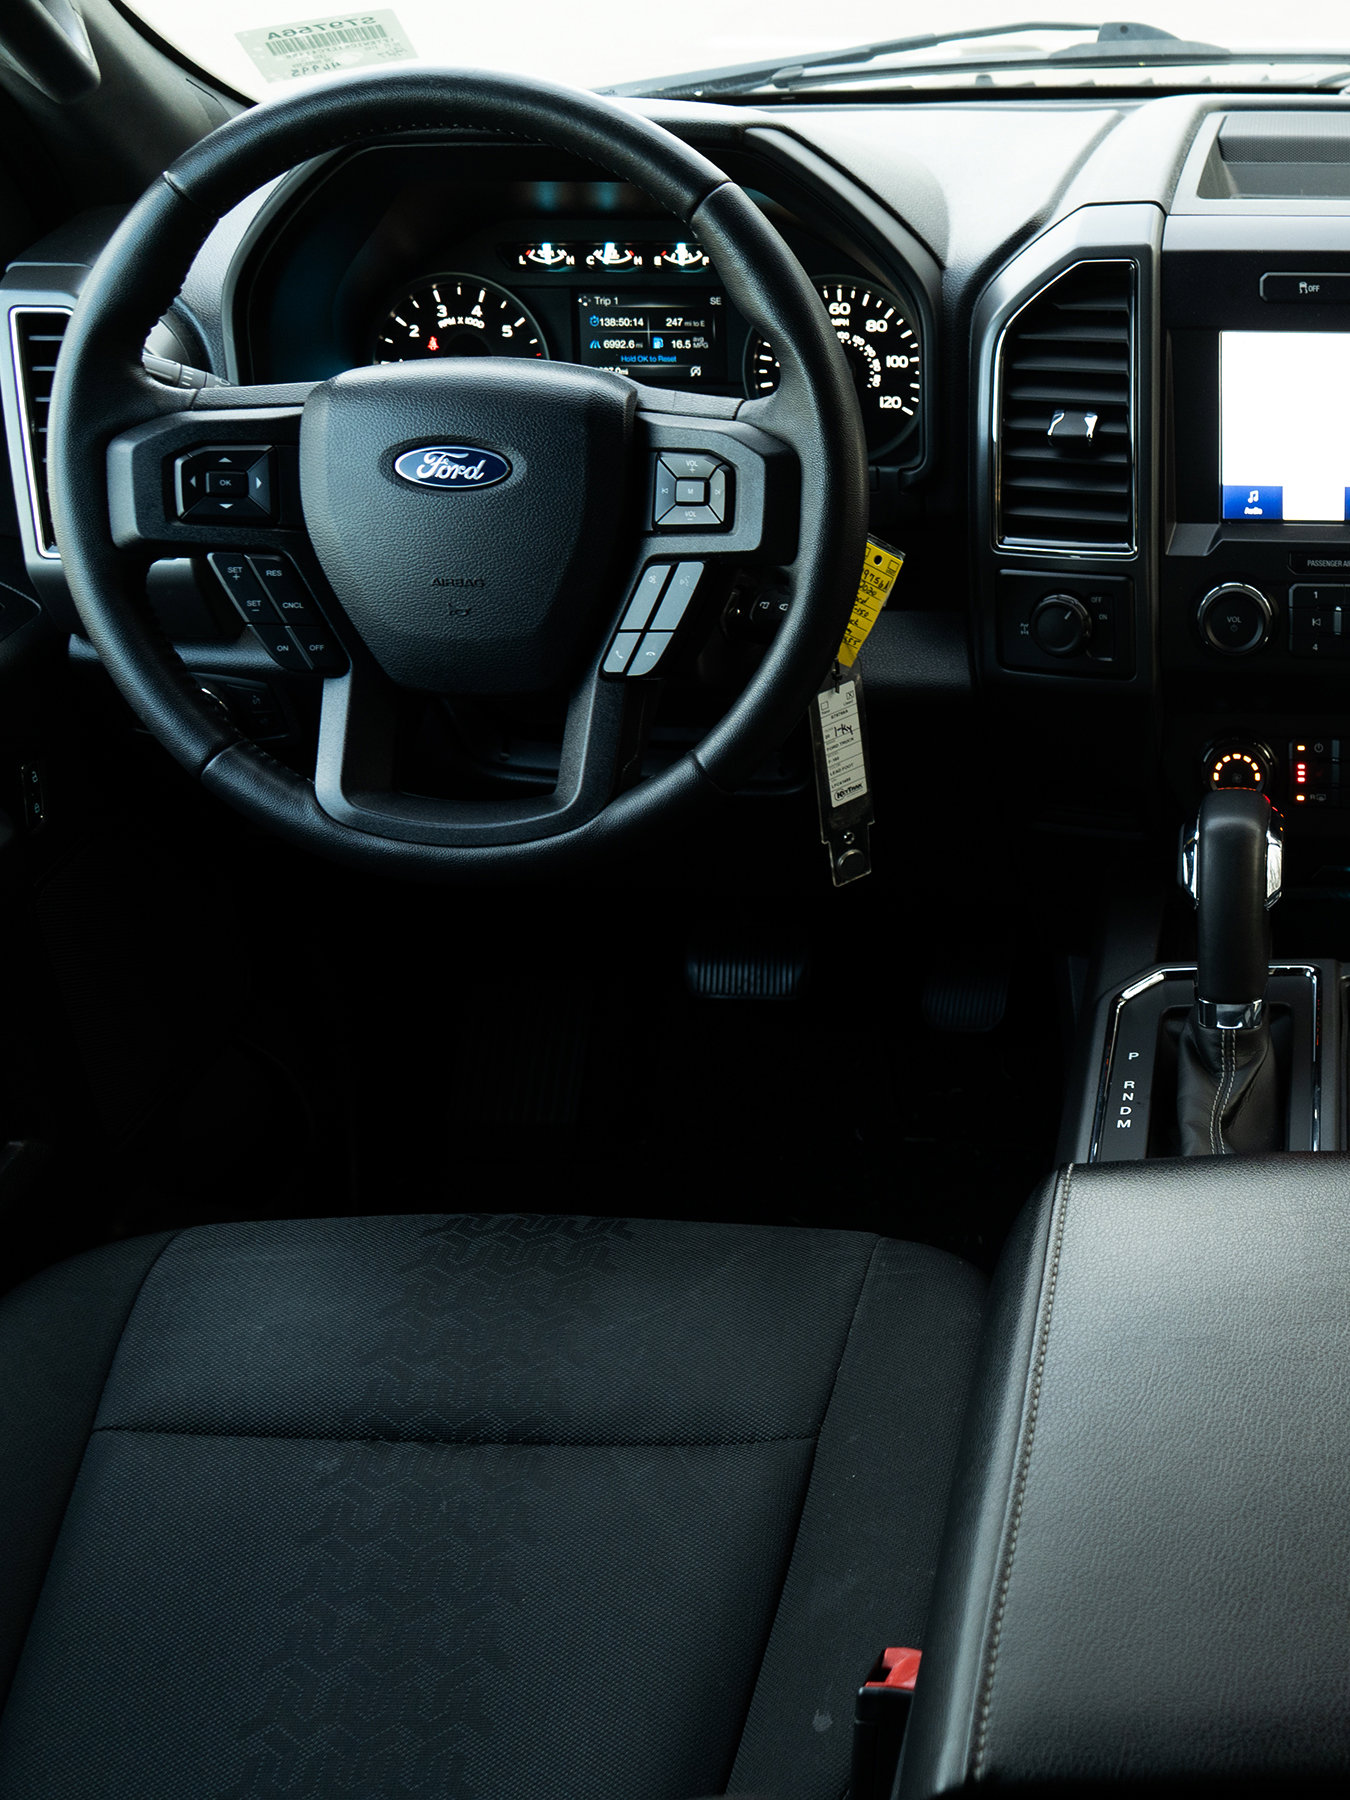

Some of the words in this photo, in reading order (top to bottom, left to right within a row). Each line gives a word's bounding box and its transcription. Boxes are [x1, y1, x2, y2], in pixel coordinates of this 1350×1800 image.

[1308, 284, 1320, 293] OFF
[594, 296, 611, 306] Trip
[709, 297, 722, 305] SE
[436, 305, 448, 317] 3
[471, 305, 483, 317] 4
[828, 302, 851, 315] 60
[437, 317, 457, 329] RPM
[599, 318, 644, 327] 138:50:14
[665, 318, 683, 327] 247
[865, 319, 888, 332] 80
[409, 325, 420, 337] 2
[502, 325, 513, 337] 5
[603, 340, 635, 348] 6992.6
[671, 340, 691, 348] 16.5
[886, 355, 909, 368] 100
[879, 396, 902, 408] 120
[416, 451, 487, 480] Ford
[219, 479, 232, 487] OK
[1307, 560, 1342, 568] PASSENGER
[432, 577, 485, 587] AIRBAG
[1227, 616, 1242, 624] VOL
[1128, 1052, 1139, 1060] P
[1124, 1080, 1135, 1089] R
[1122, 1093, 1134, 1101] N
[1120, 1107, 1132, 1115] D
[1116, 1119, 1131, 1128] M
